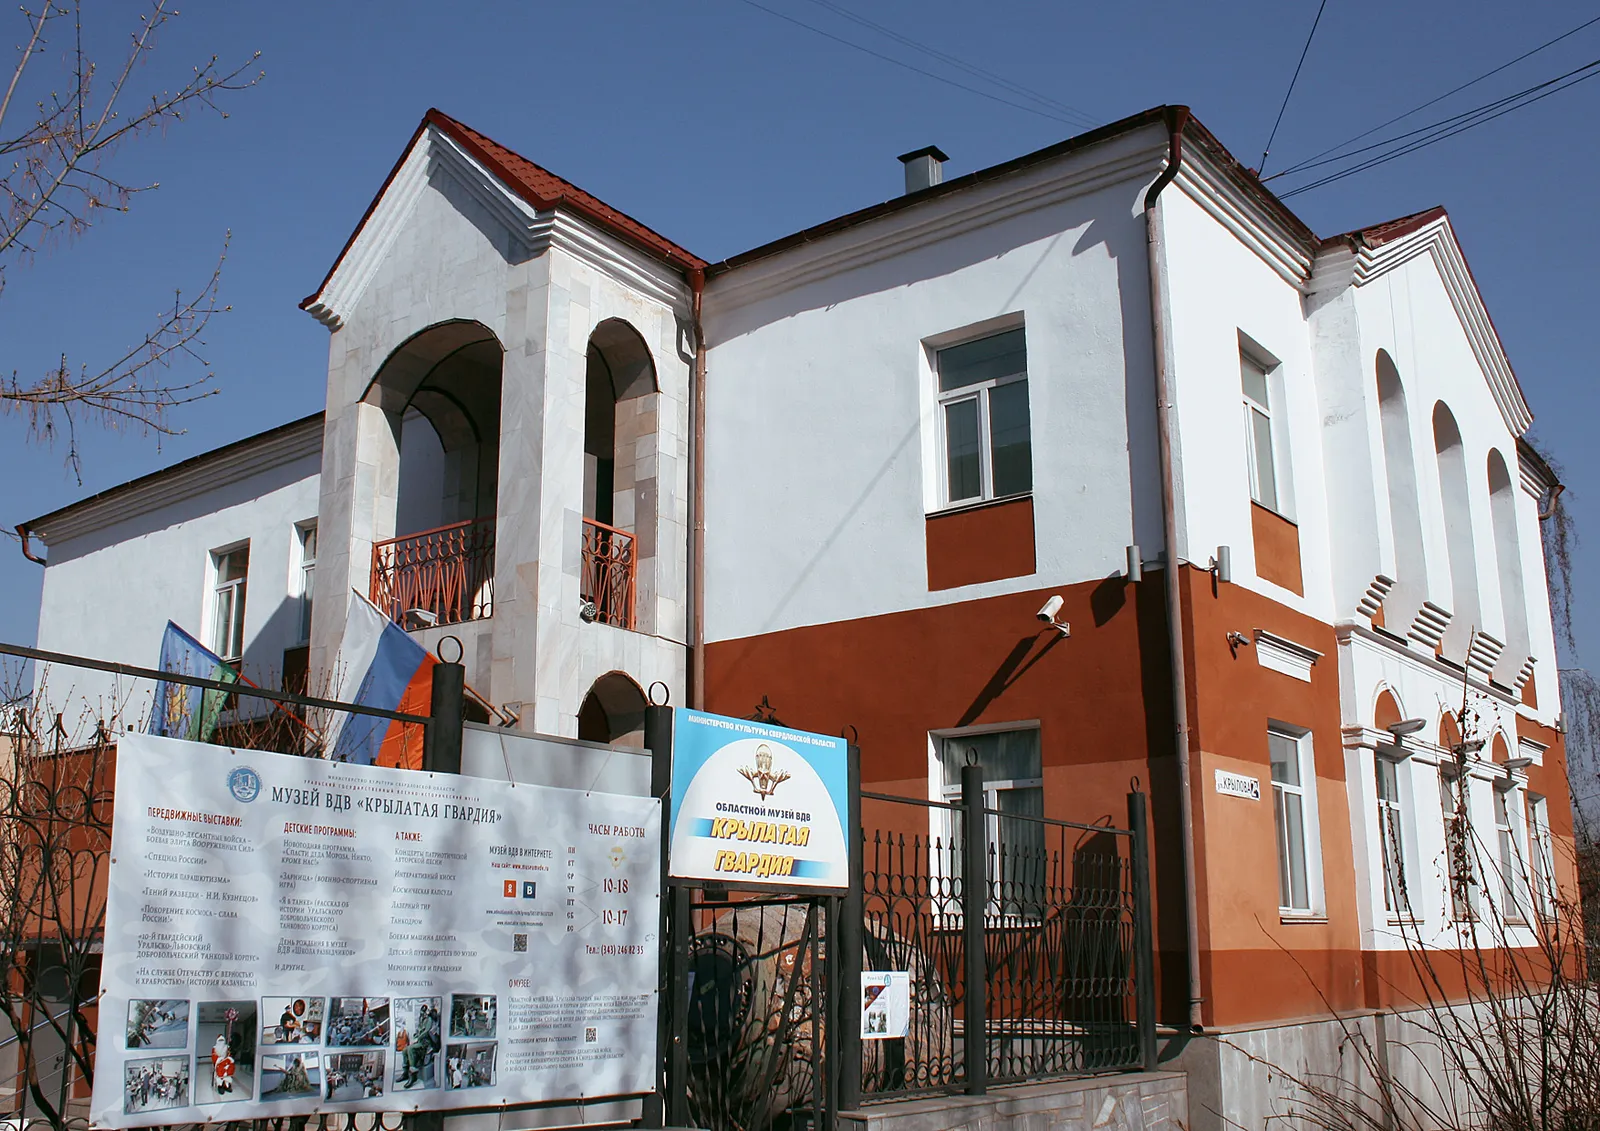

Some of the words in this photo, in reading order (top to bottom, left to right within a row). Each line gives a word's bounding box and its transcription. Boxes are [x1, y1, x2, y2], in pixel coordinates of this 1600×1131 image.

[688, 714, 734, 731] МИНИСТЕРСТВО
[735, 724, 769, 737] КУЛЬТУРЫ
[769, 730, 811, 744] СВЕРДЛОВСКОЙ
[811, 737, 836, 749] ОБЛАСТИ
[1223, 777, 1251, 793] КРЫЛОВА
[272, 786, 319, 807] МУЗЕЙ
[325, 793, 351, 813] ВДВ
[357, 797, 438, 818] «КРЫЛАТАЯ
[444, 804, 502, 825] ГВАРДИЯ»
[716, 802, 766, 816] ОБЛАСТНОЙ
[767, 807, 795, 820] МУЗЕЙ
[795, 811, 811, 823] ВДВ
[148, 807, 202, 822] ПЕРЕДВИЖНЫЕ
[204, 814, 243, 828] ВЫСТАВКИ:
[284, 822, 312, 835] ДЕТСКИЕ
[313, 825, 357, 838] ПРОГРАММЫ:
[395, 832, 399, 840] А
[401, 832, 423, 842] ТАКЖЕ:
[588, 823, 610, 835] ЧАСЫ
[613, 826, 645, 838] РАБОТЫ
[711, 817, 811, 847] КРЫЛАТАЯ
[489, 845, 508, 856] МУЗЕЙ
[508, 848, 519, 858] ВДВ
[524, 849, 553, 859] ИНТЕРНЕТЕ:
[714, 850, 795, 878] ГВАРДИЯ
[603, 878, 629, 893] 10-18
[602, 910, 628, 926] 10-17
[277, 944, 291, 955] ВДВ
[585, 944, 600, 954] Тел.:
[601, 944, 616, 956] (343)
[617, 945, 627, 955] 246
[628, 945, 636, 955] 82
[636, 945, 644, 955] 35
[508, 979, 513, 988] О
[513, 979, 531, 988] МУЗЕЕ:
